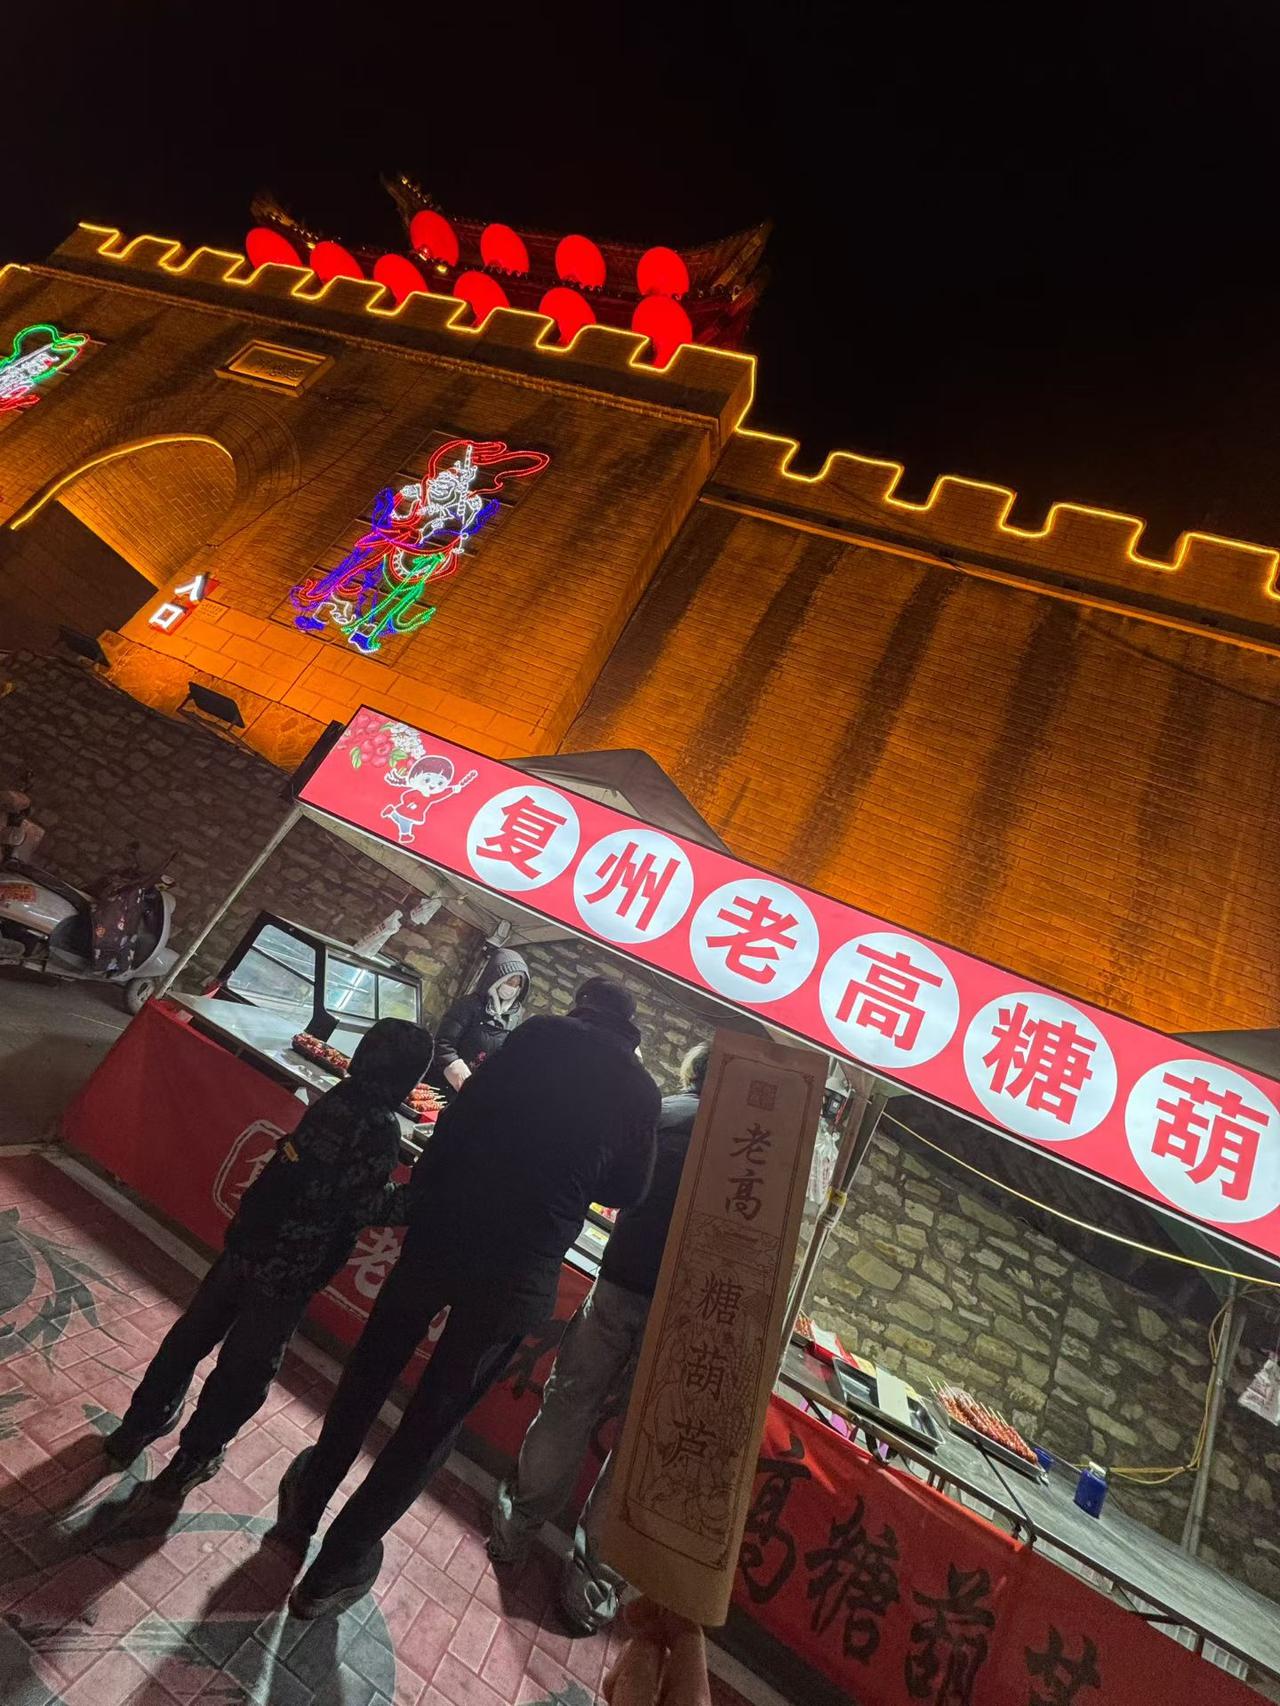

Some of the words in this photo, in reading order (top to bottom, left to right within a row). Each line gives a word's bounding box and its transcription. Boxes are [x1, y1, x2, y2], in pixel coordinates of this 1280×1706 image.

[148, 574, 205, 630] 入口
[476, 795, 1269, 1201] 复州老高糖葫
[724, 1122, 772, 1221] 老高
